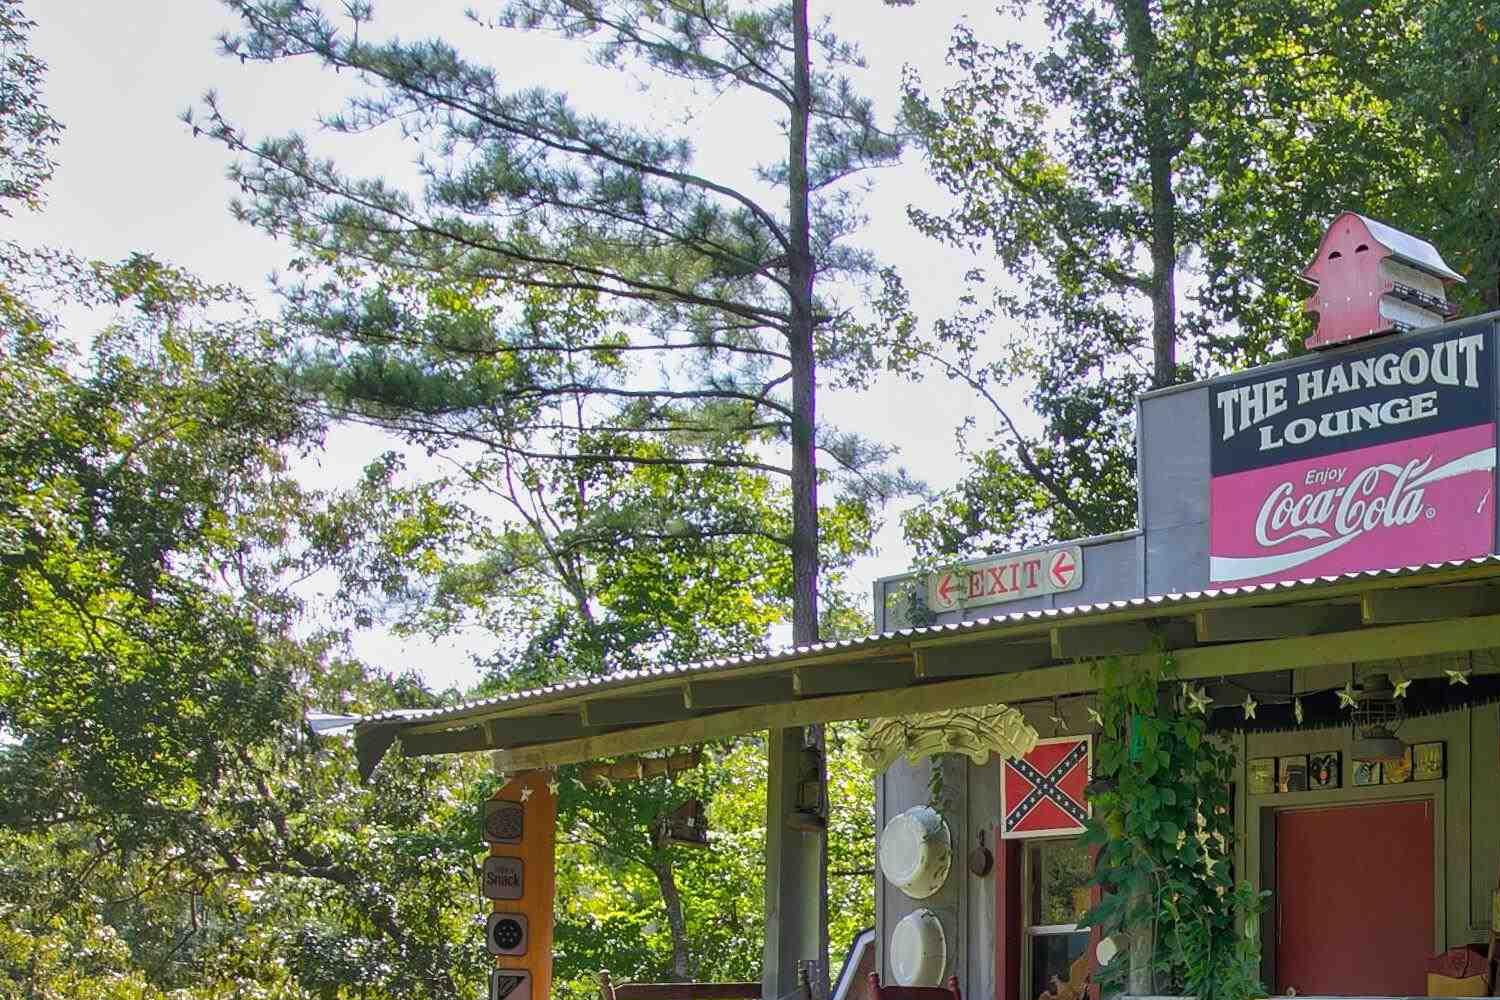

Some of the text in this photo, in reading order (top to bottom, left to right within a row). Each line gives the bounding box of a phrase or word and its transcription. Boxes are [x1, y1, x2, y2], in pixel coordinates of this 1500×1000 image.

[1217, 333, 1484, 441] THE HANGOUT
[1258, 390, 1439, 451] LOUNGE
[1255, 453, 1433, 546] Coca-Cola
[1305, 466, 1348, 486] Enjoy
[966, 559, 1041, 599] EXIT
